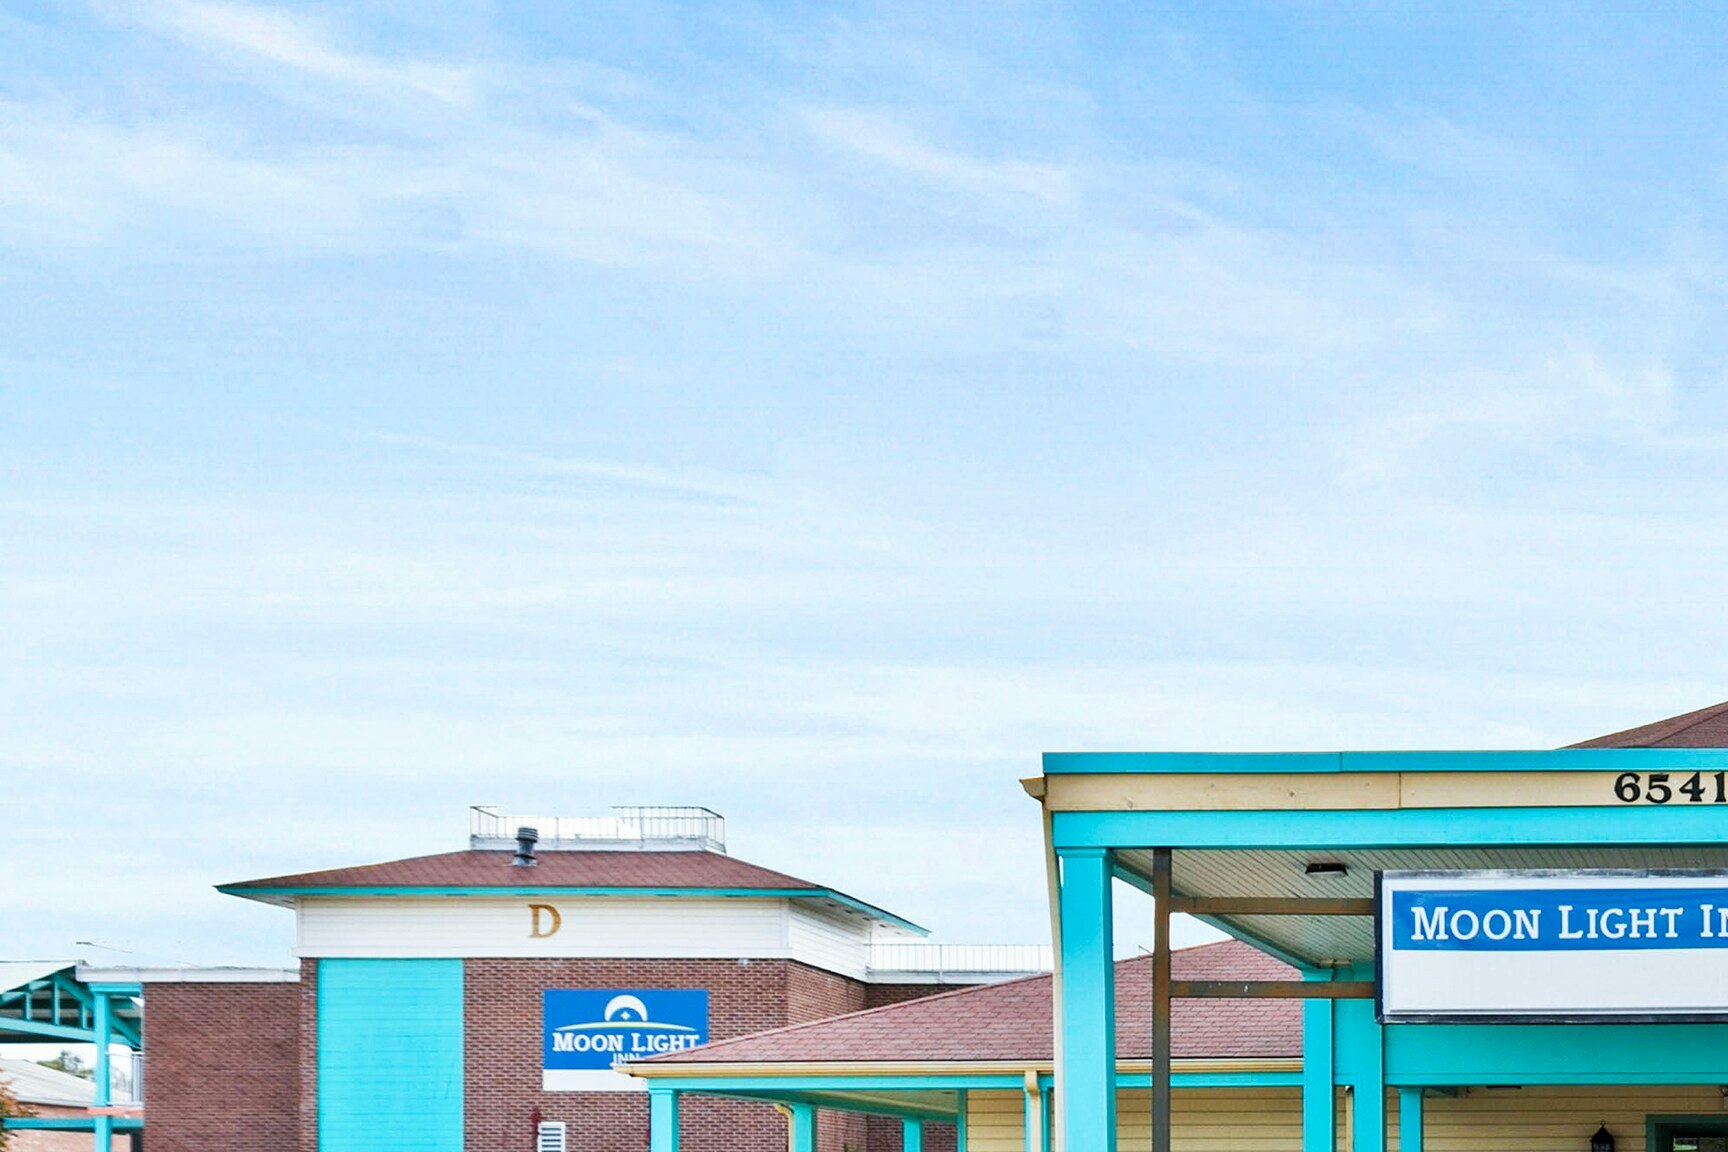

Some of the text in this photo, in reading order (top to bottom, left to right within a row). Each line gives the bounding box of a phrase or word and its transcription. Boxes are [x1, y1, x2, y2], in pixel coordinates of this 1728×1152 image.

[1614, 771, 1727, 804] 6541
[528, 904, 561, 938] D
[1411, 906, 1541, 941] MOON
[1558, 905, 1684, 939] LIGHT
[552, 1032, 699, 1052] MOON LIGHT
